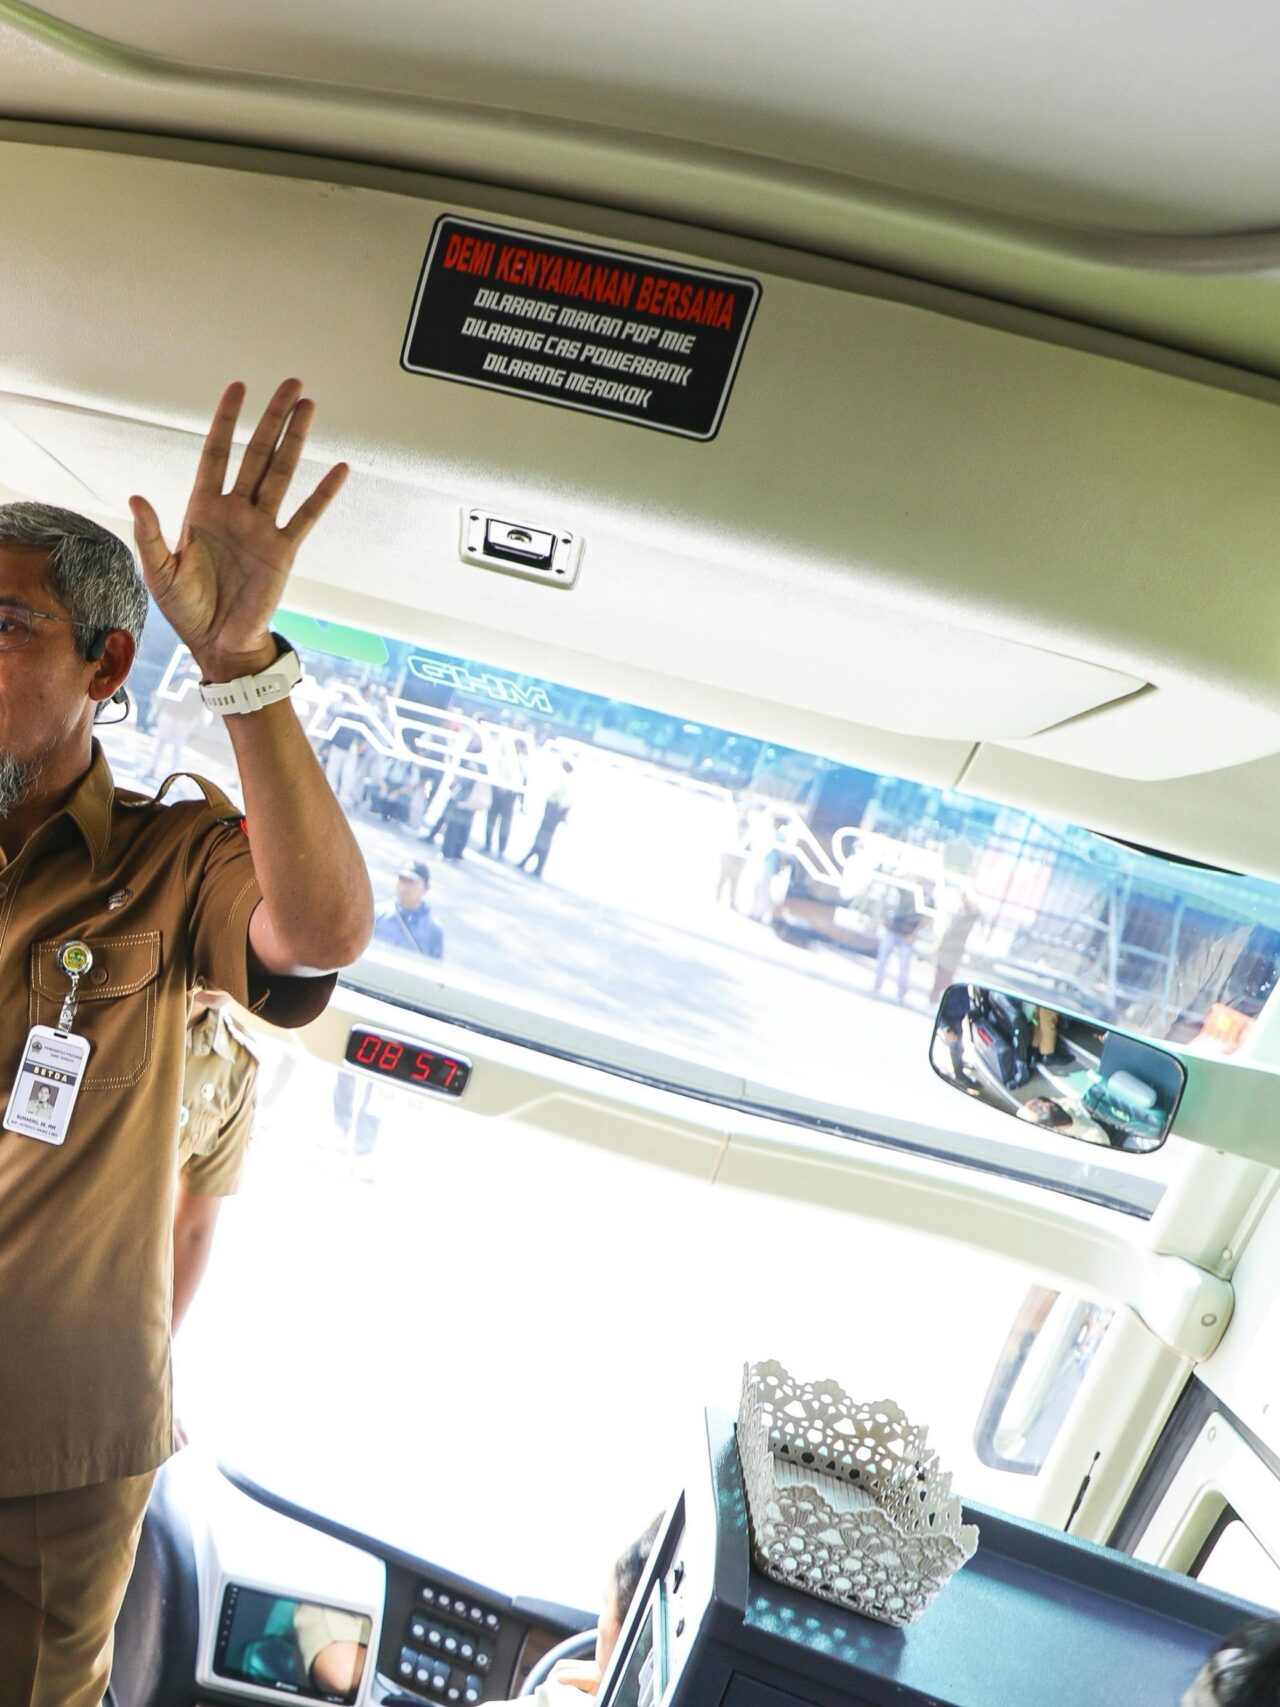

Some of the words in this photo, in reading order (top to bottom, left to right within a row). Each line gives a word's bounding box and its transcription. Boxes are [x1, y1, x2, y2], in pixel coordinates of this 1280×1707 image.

[443, 233, 493, 273] DEMI
[494, 245, 635, 307] KENYAMANAN
[635, 276, 736, 331] BERSAMA
[460, 316, 546, 352] DILARANG
[544, 337, 581, 360] CAS
[580, 344, 693, 387] POWERBANK
[473, 288, 558, 324] DILARANG
[557, 304, 623, 338] MAKAN
[620, 320, 660, 345] POP
[657, 329, 697, 354] MIE
[482, 352, 566, 388] DILARANG
[564, 371, 653, 408] MEROKOK
[355, 1033, 404, 1072] 08
[410, 1052, 460, 1088] 57
